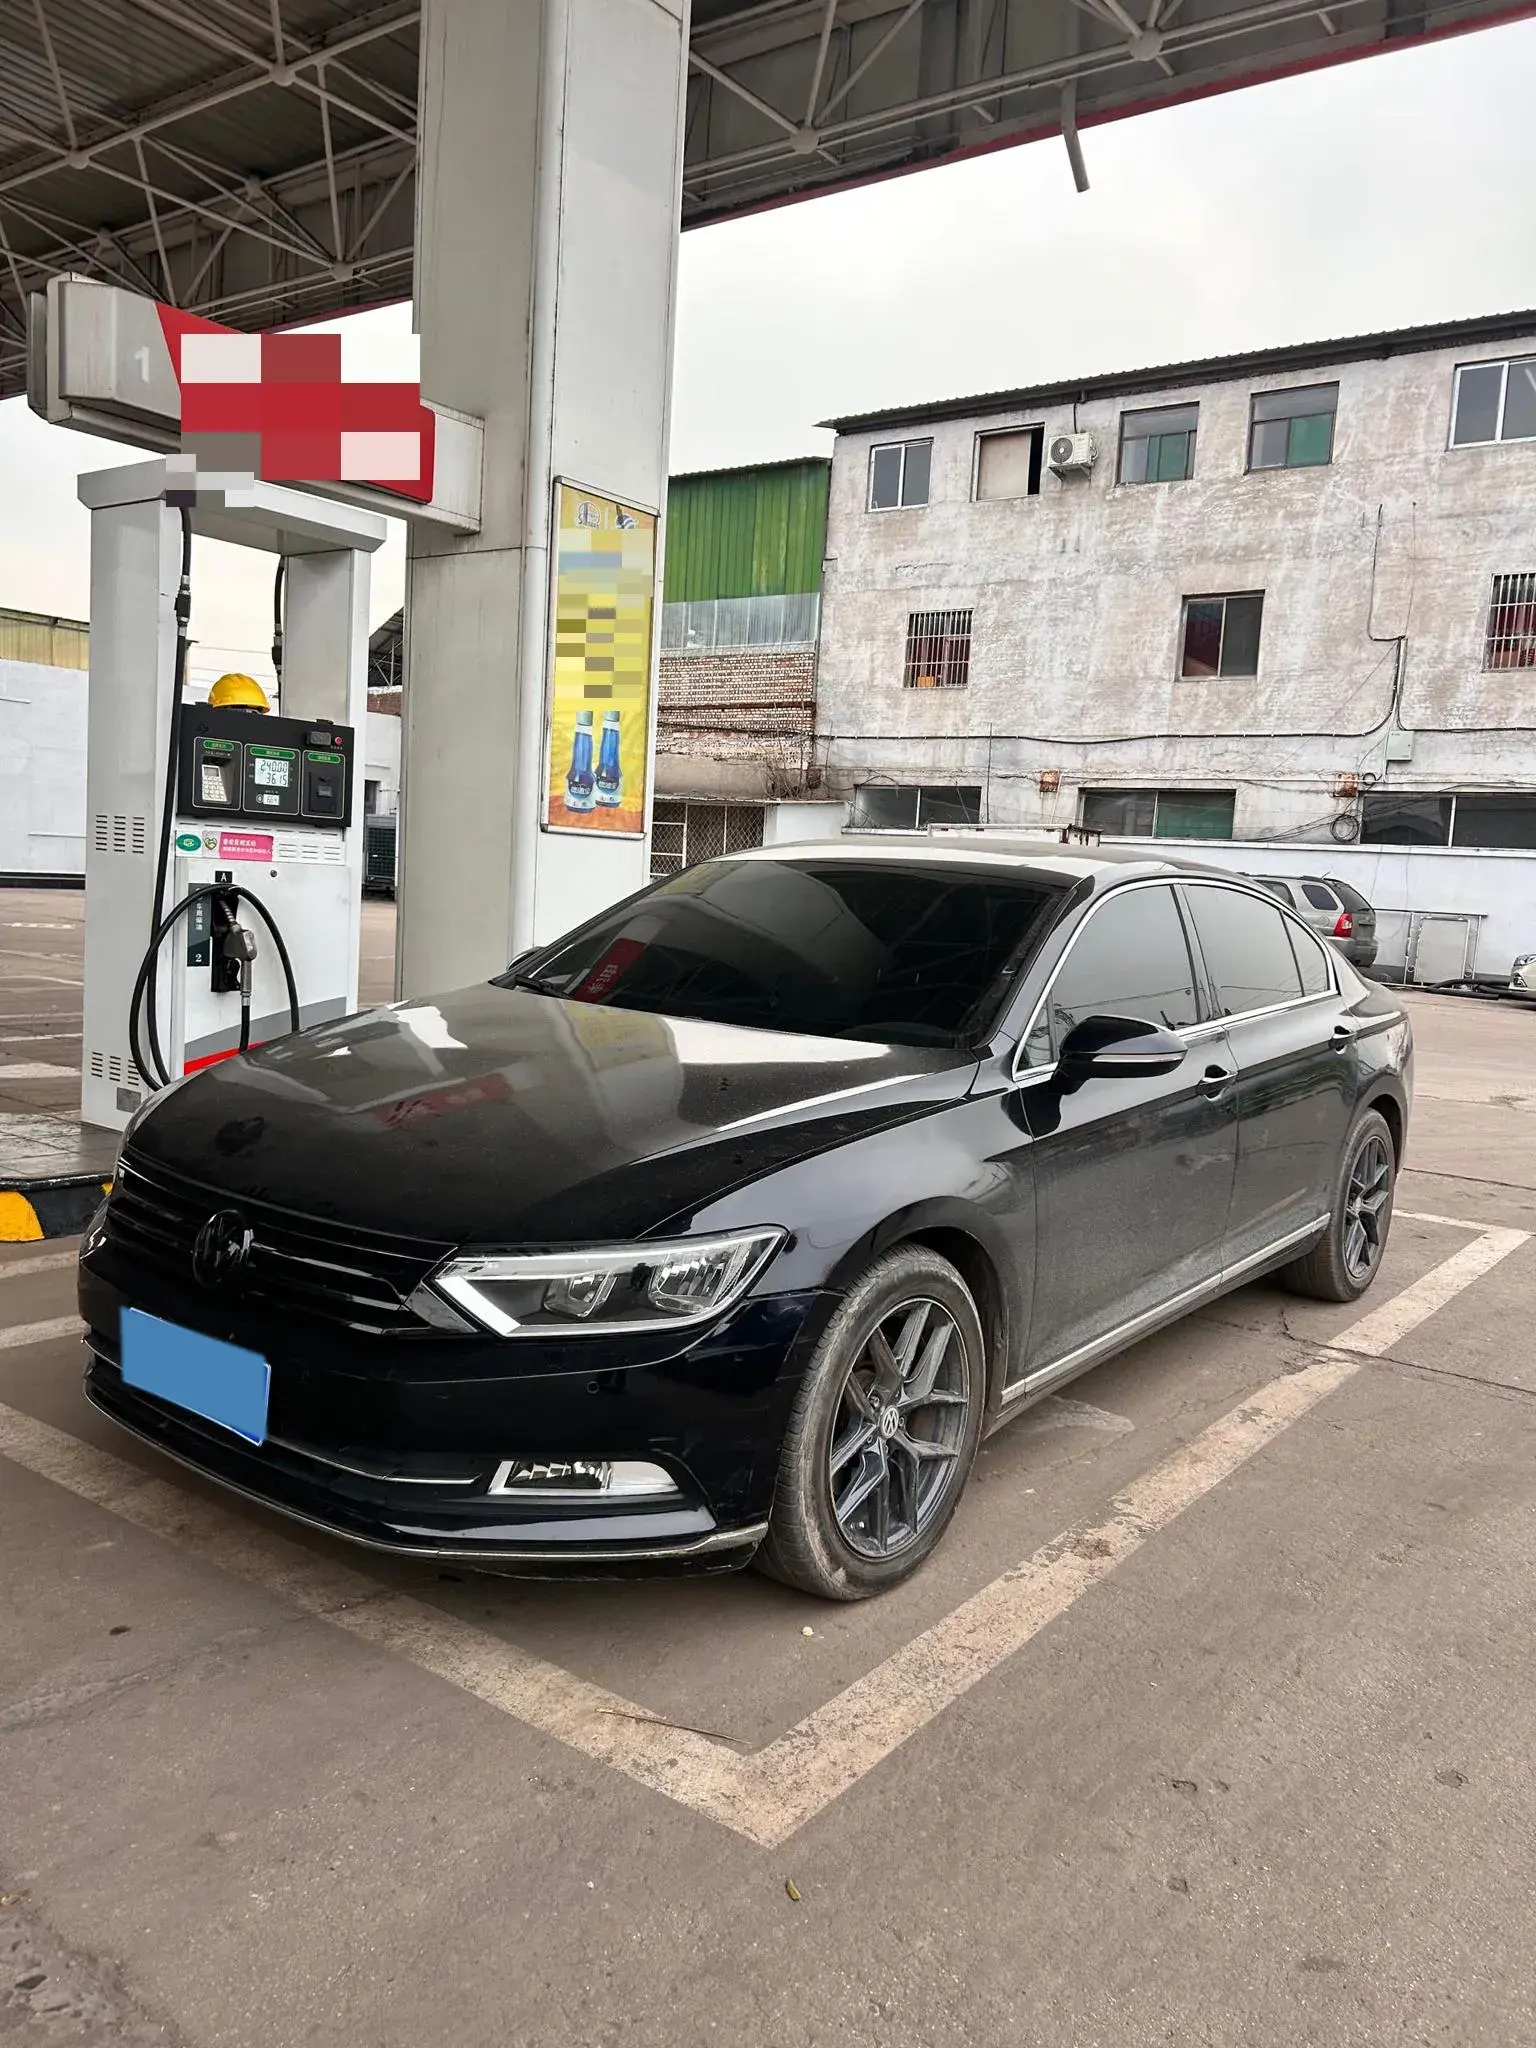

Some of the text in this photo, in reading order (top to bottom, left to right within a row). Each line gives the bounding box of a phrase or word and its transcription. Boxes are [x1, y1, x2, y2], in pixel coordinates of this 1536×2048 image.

[134, 346, 150, 383] 1
[220, 872, 227, 882] A
[195, 953, 202, 962] 2
